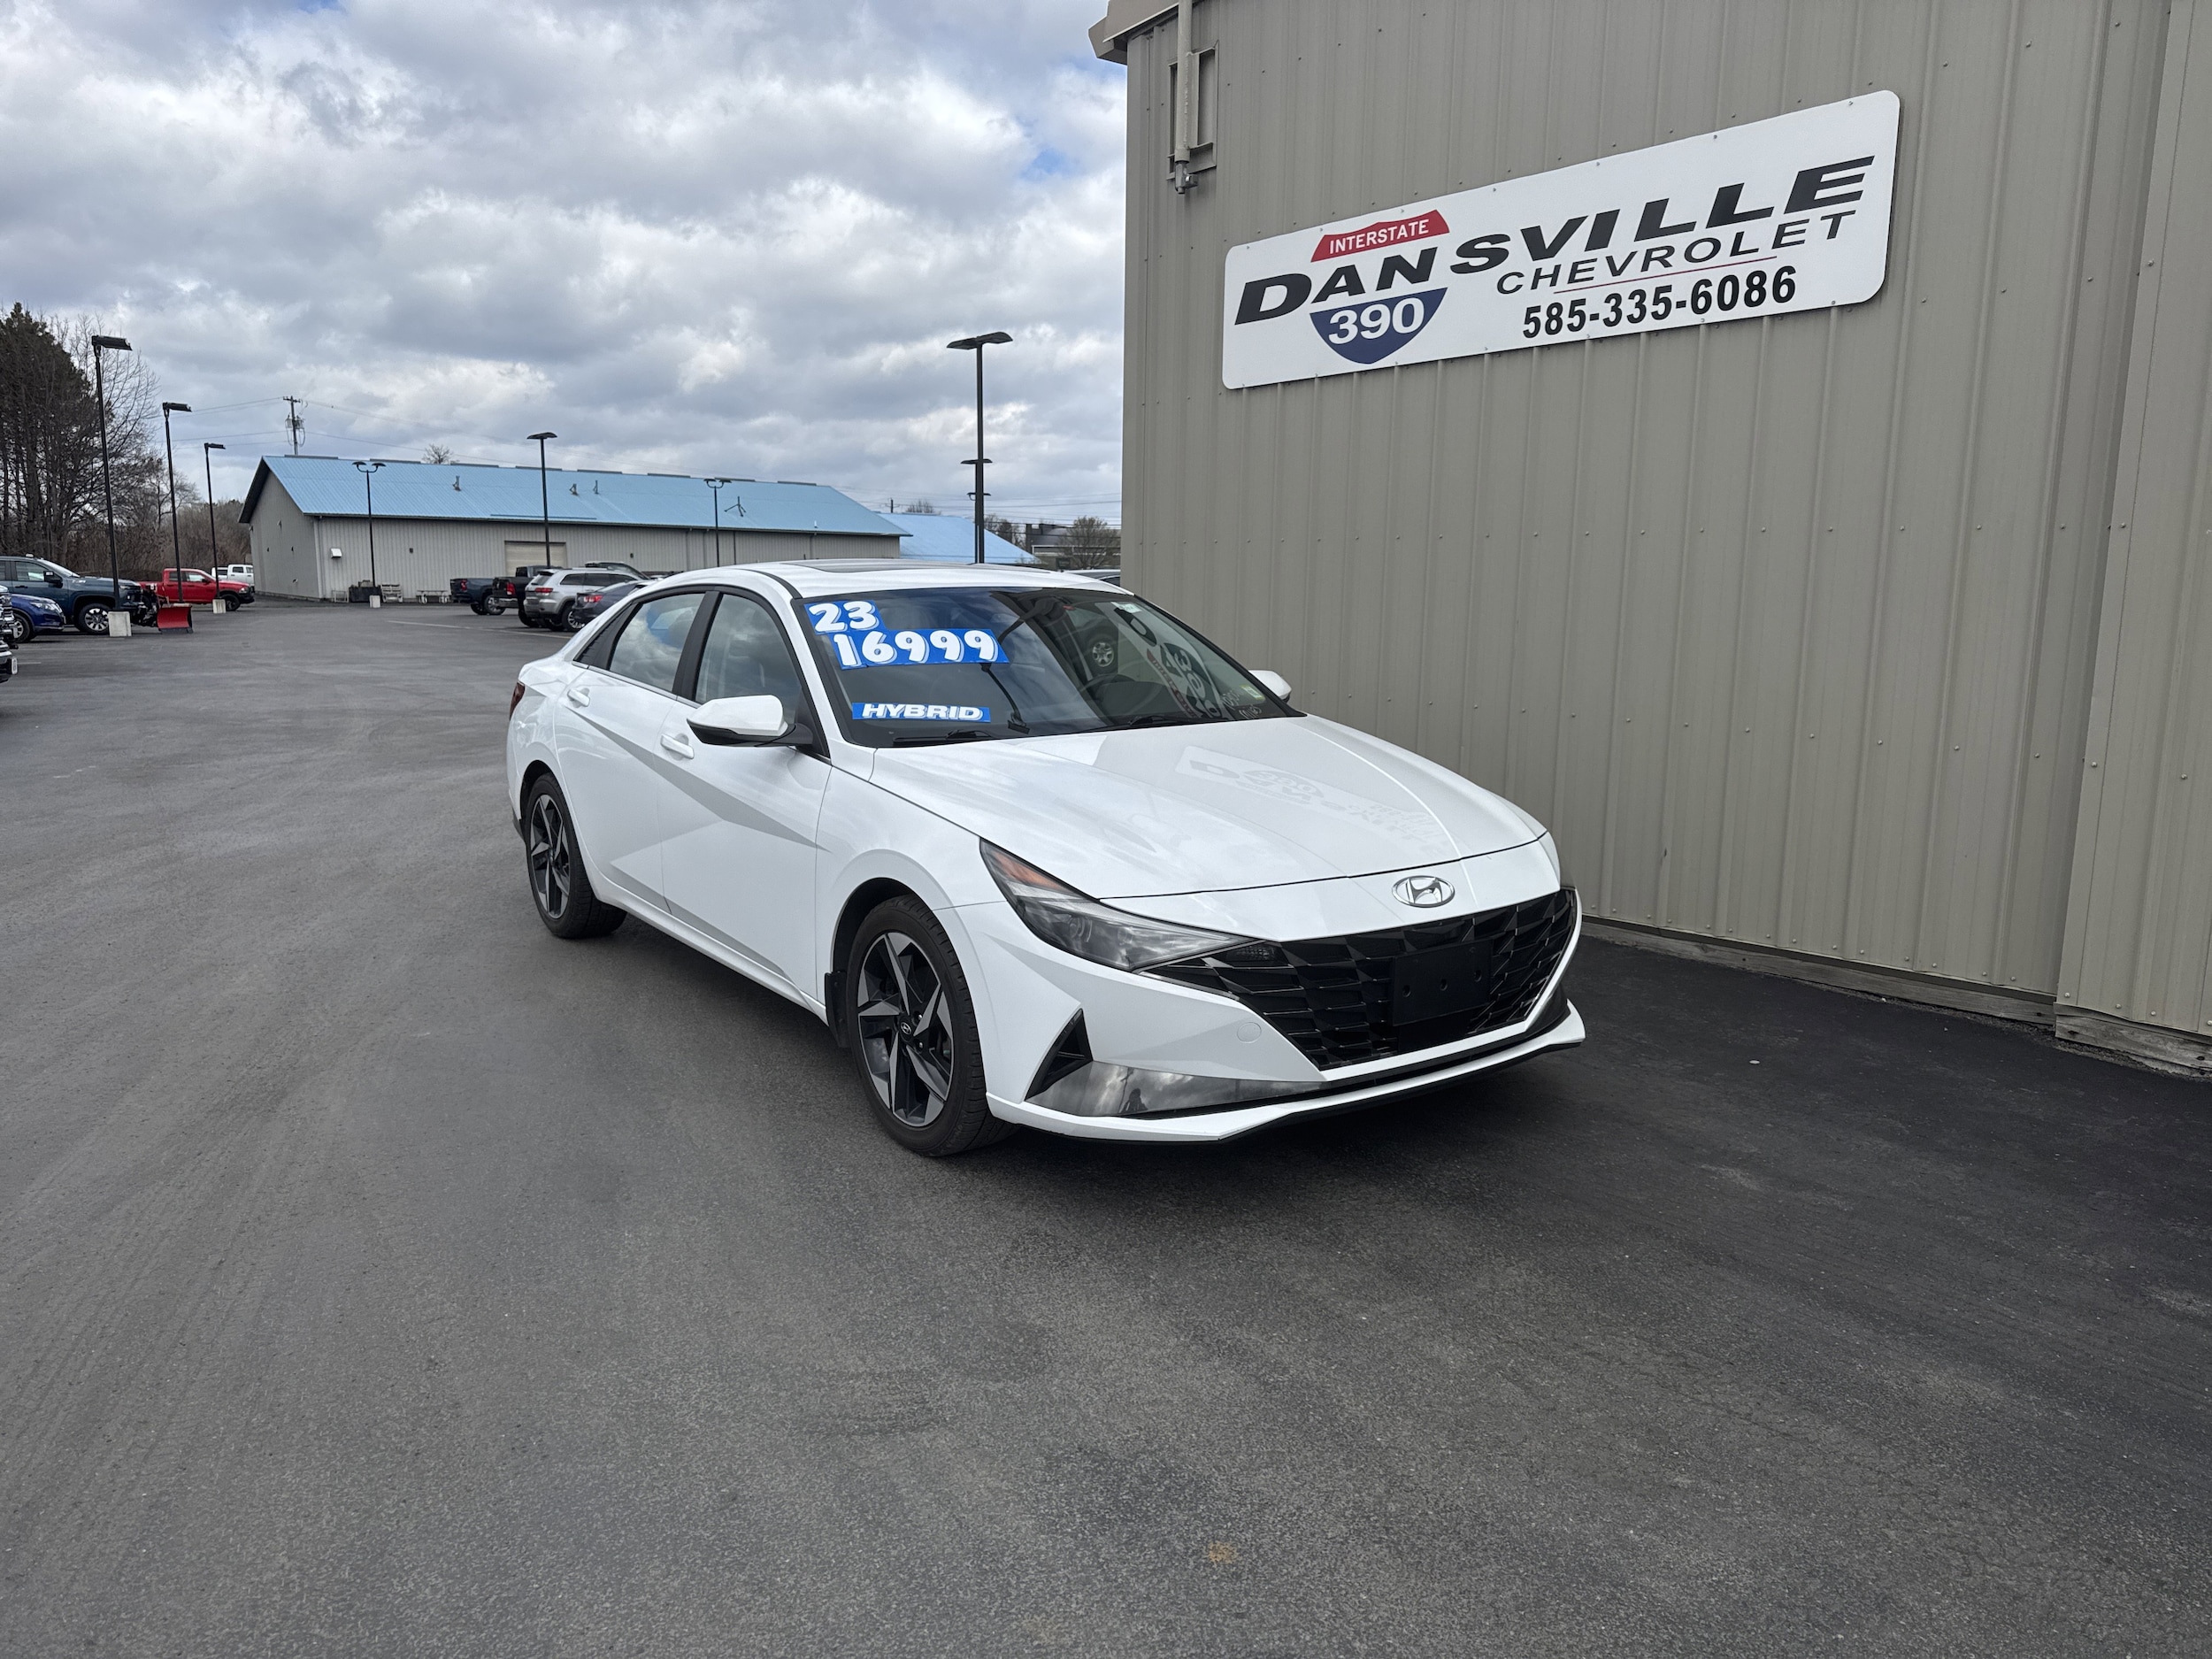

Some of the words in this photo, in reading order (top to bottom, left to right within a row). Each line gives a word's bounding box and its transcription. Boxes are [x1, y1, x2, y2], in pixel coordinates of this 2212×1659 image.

[1234, 155, 1875, 326] DANSVILLE
[1329, 219, 1430, 255] INTERSTATE
[1496, 210, 1856, 294] CHEVROLET
[1328, 297, 1425, 344] 390
[1523, 265, 1797, 338] 585-335-6086
[808, 601, 880, 633] 23
[833, 629, 998, 666] 16999
[861, 703, 984, 720] HYBRID
